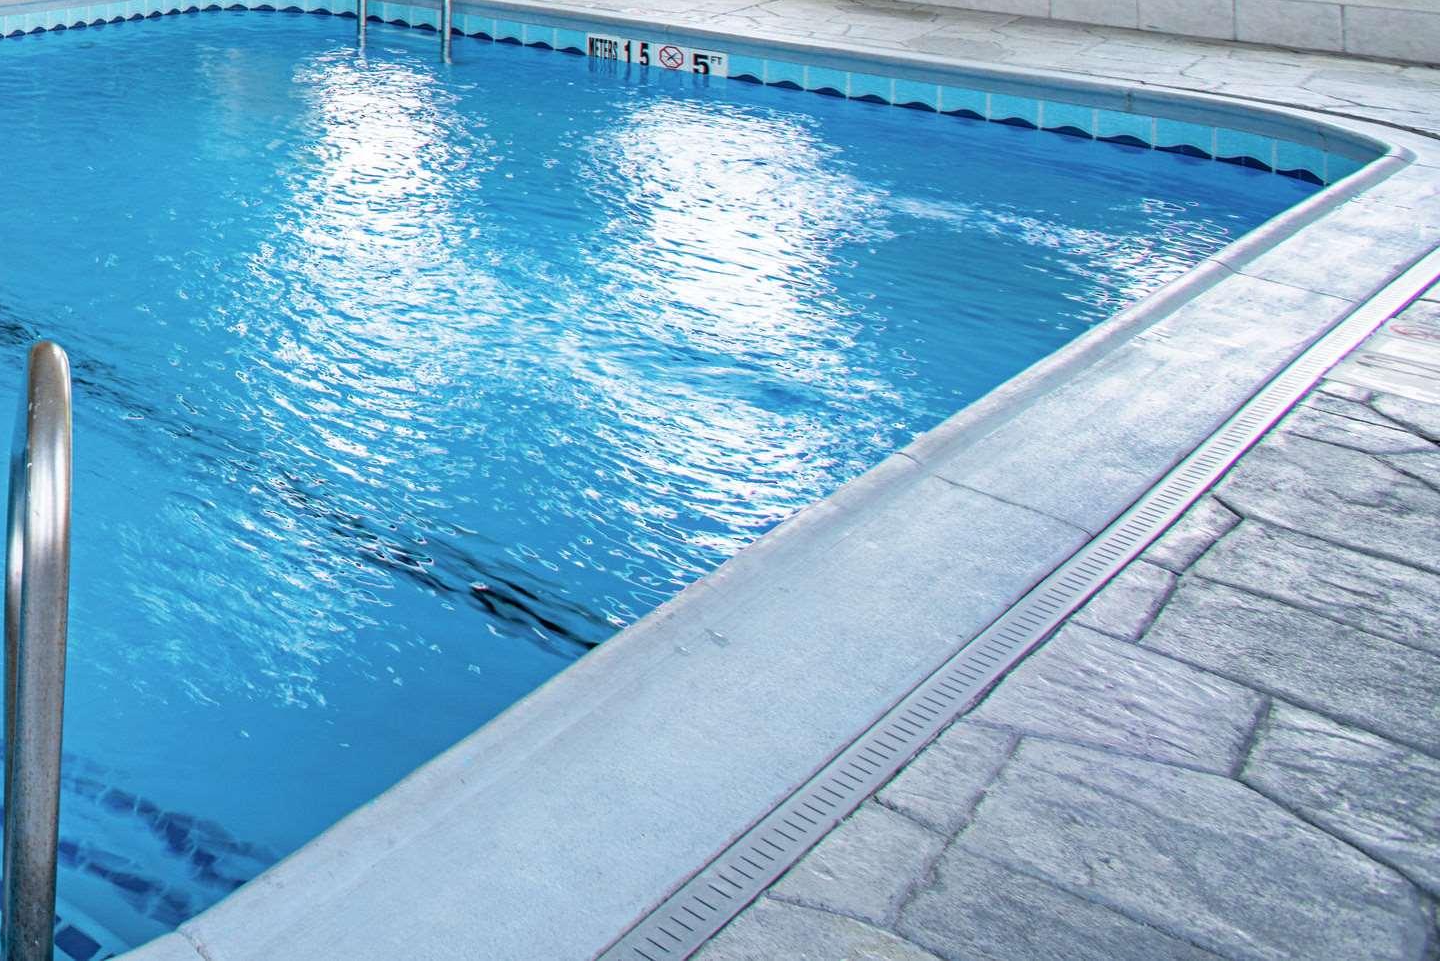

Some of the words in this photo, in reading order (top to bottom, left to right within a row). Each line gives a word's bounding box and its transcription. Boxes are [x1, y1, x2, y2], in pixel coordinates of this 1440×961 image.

[588, 37, 618, 61] METERS
[692, 53, 709, 75] 5
[711, 56, 723, 65] FT
